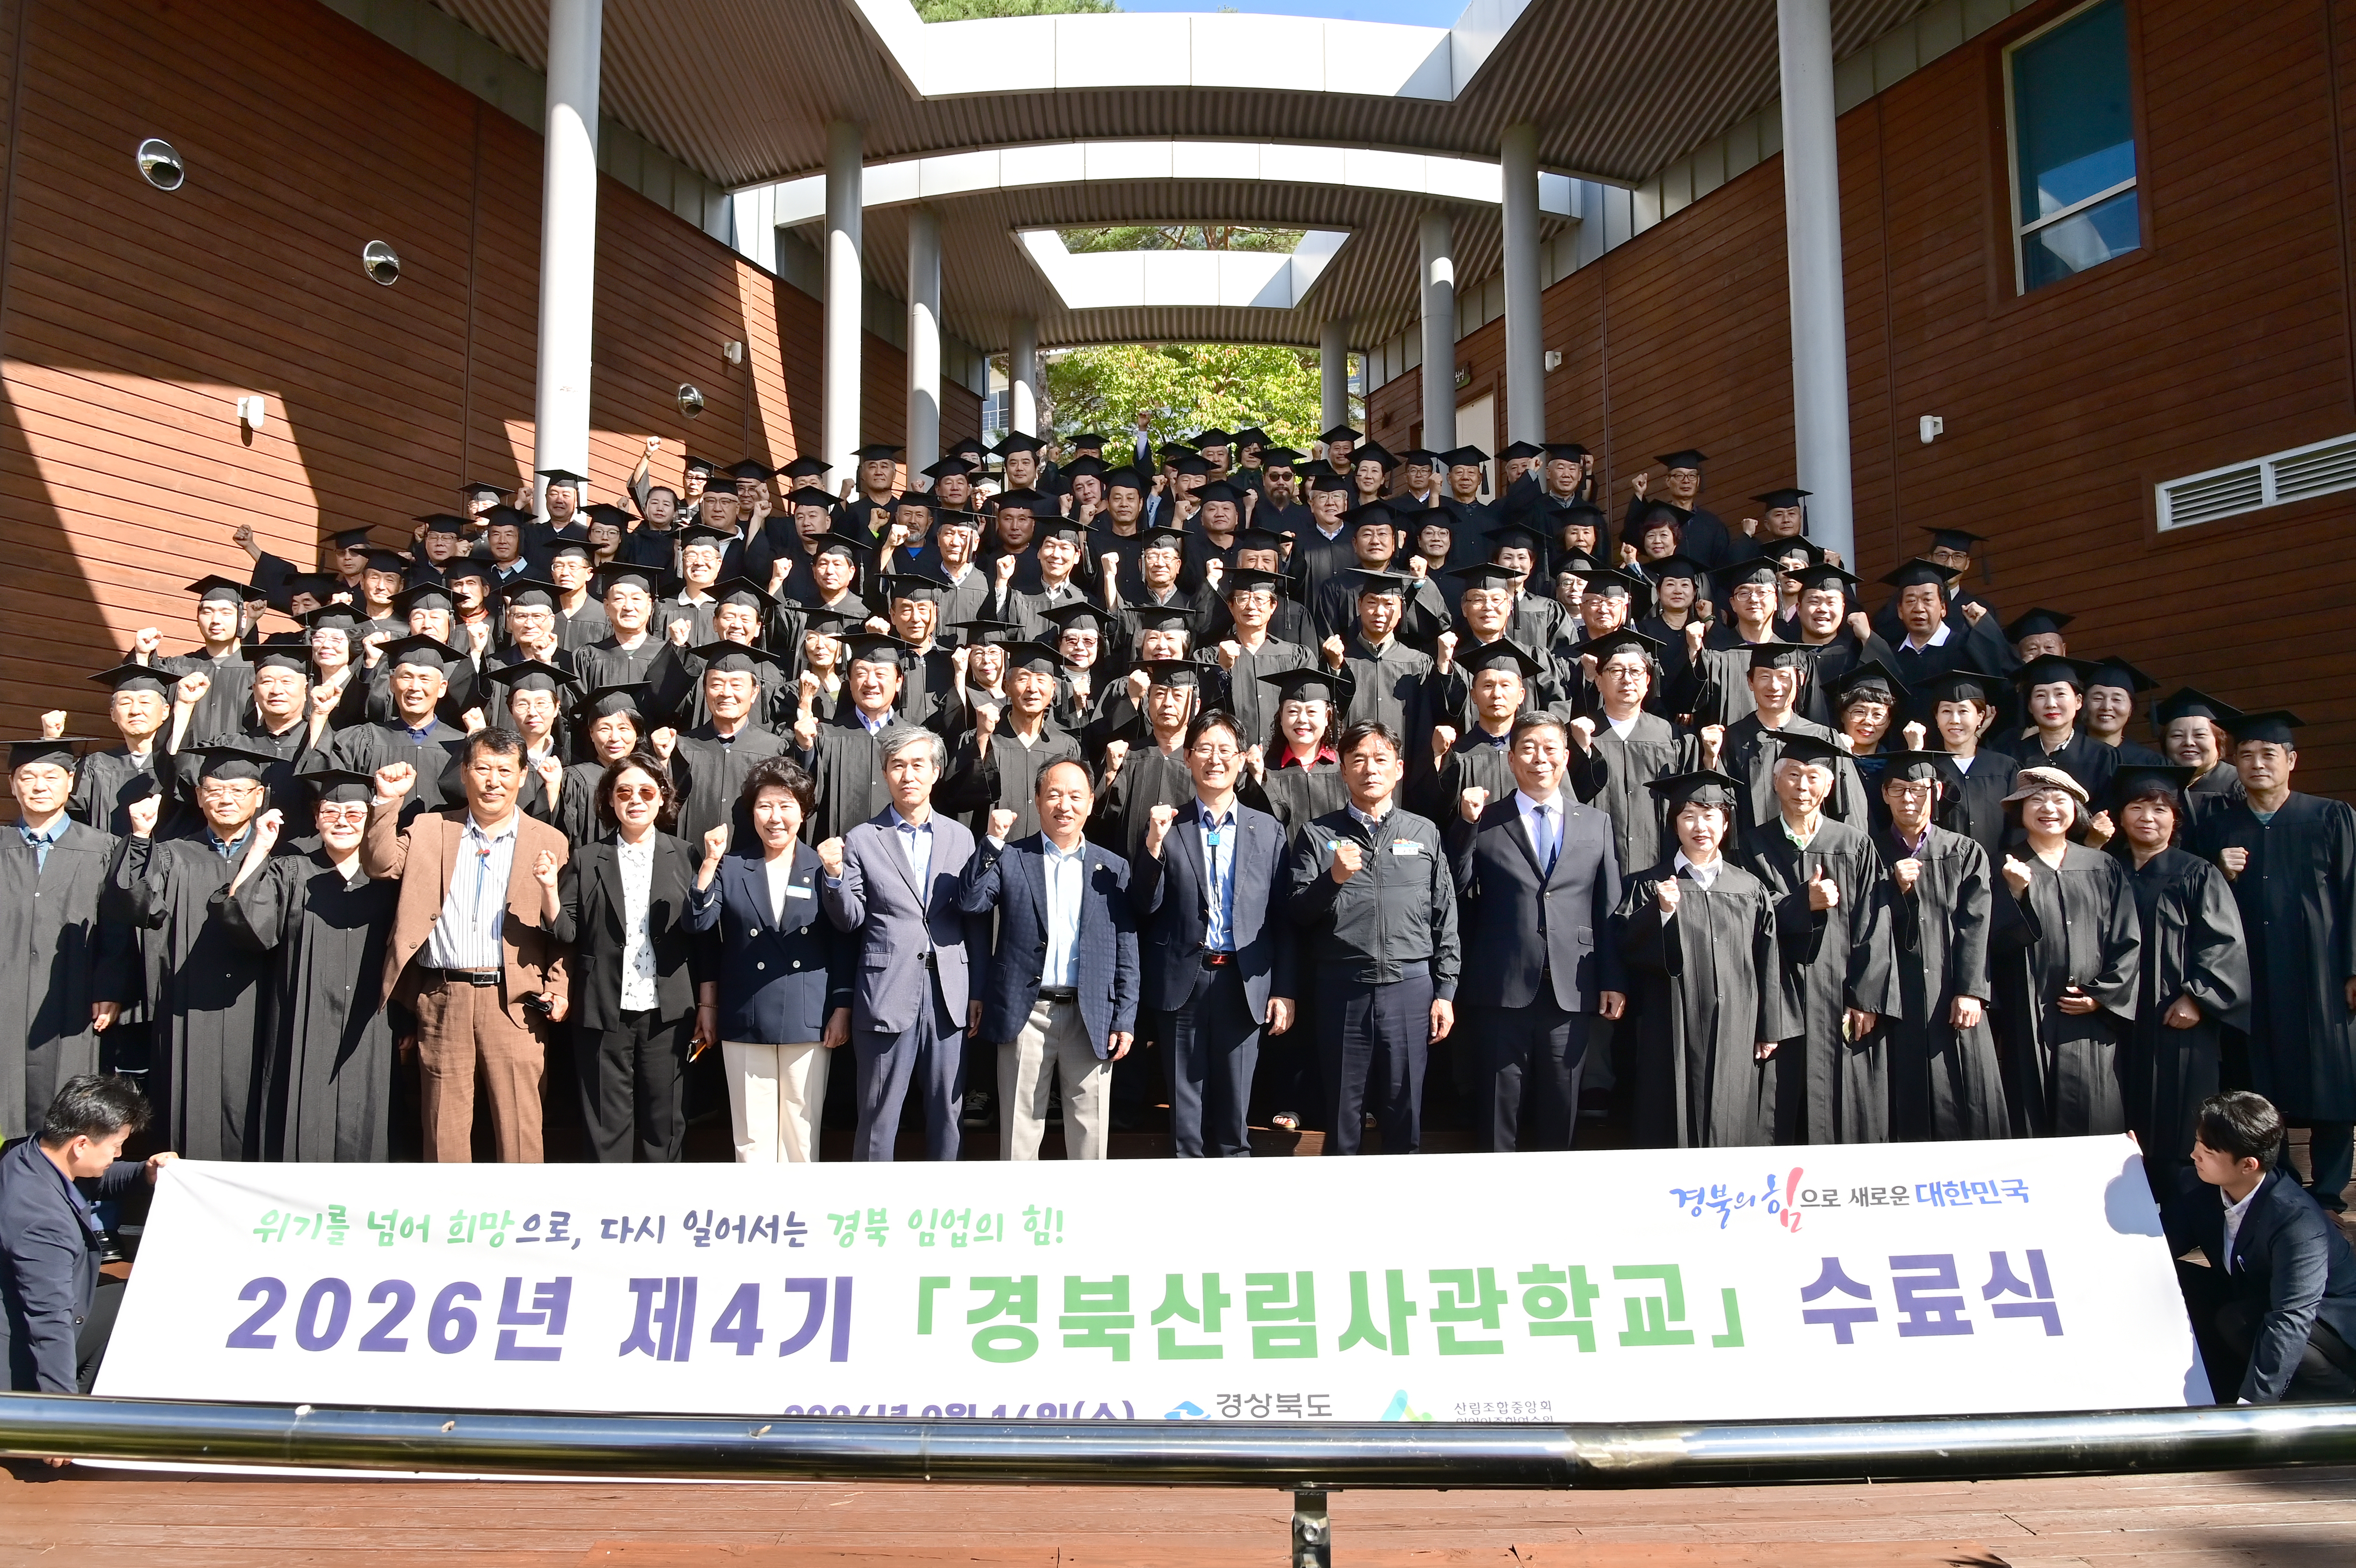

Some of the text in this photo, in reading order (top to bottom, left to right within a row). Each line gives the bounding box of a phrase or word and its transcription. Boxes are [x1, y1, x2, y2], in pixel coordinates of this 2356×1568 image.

[1670, 1167, 2029, 1233] 경북의 힘으로 새로운 대한민국
[254, 1204, 1064, 1250] 위기를 넘어 희망으로, 다시 일어서는 경북 임업의 힘!
[225, 1249, 2064, 1363] 2026년 제4기 「경북산림사관학교」 수료식
[1217, 1393, 1332, 1419] 경상북도
[1454, 1400, 1551, 1415] 산림조합중앙회
